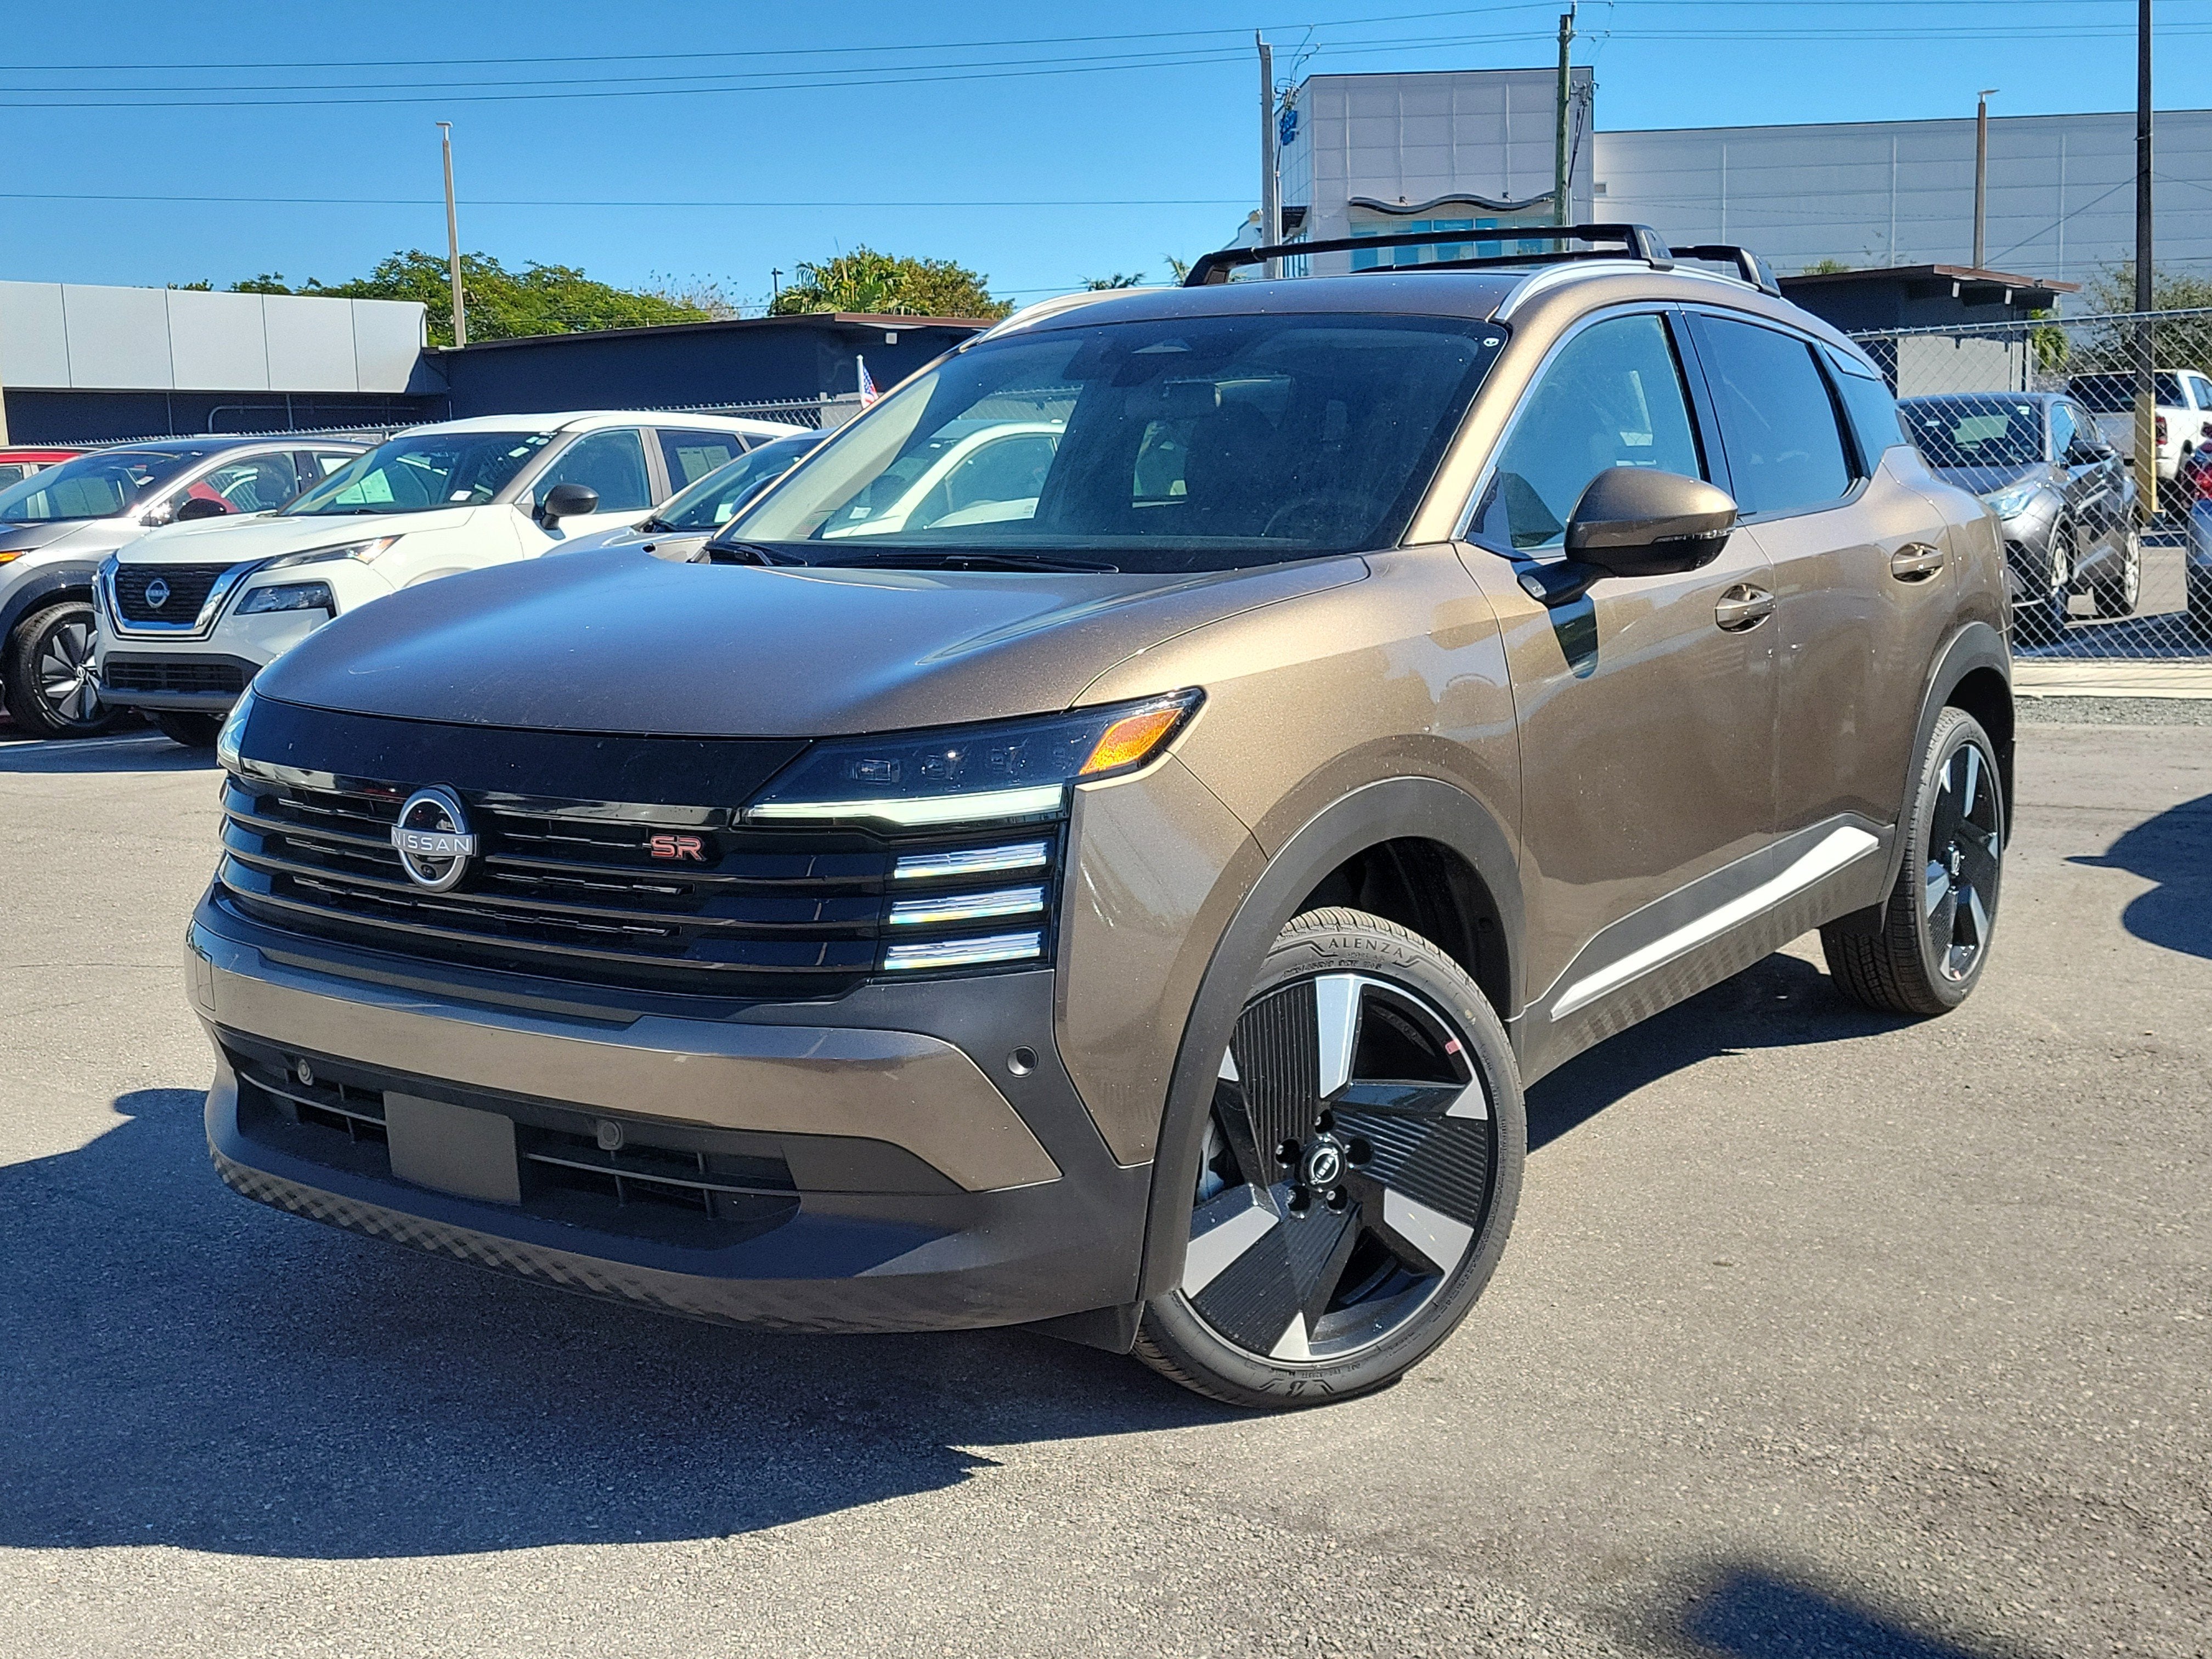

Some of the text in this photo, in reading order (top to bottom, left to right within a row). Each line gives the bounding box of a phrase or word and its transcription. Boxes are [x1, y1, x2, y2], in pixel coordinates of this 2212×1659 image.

[393, 830, 469, 851] NISSAN
[651, 835, 704, 861] SR
[1328, 938, 1403, 958] ALENZA
